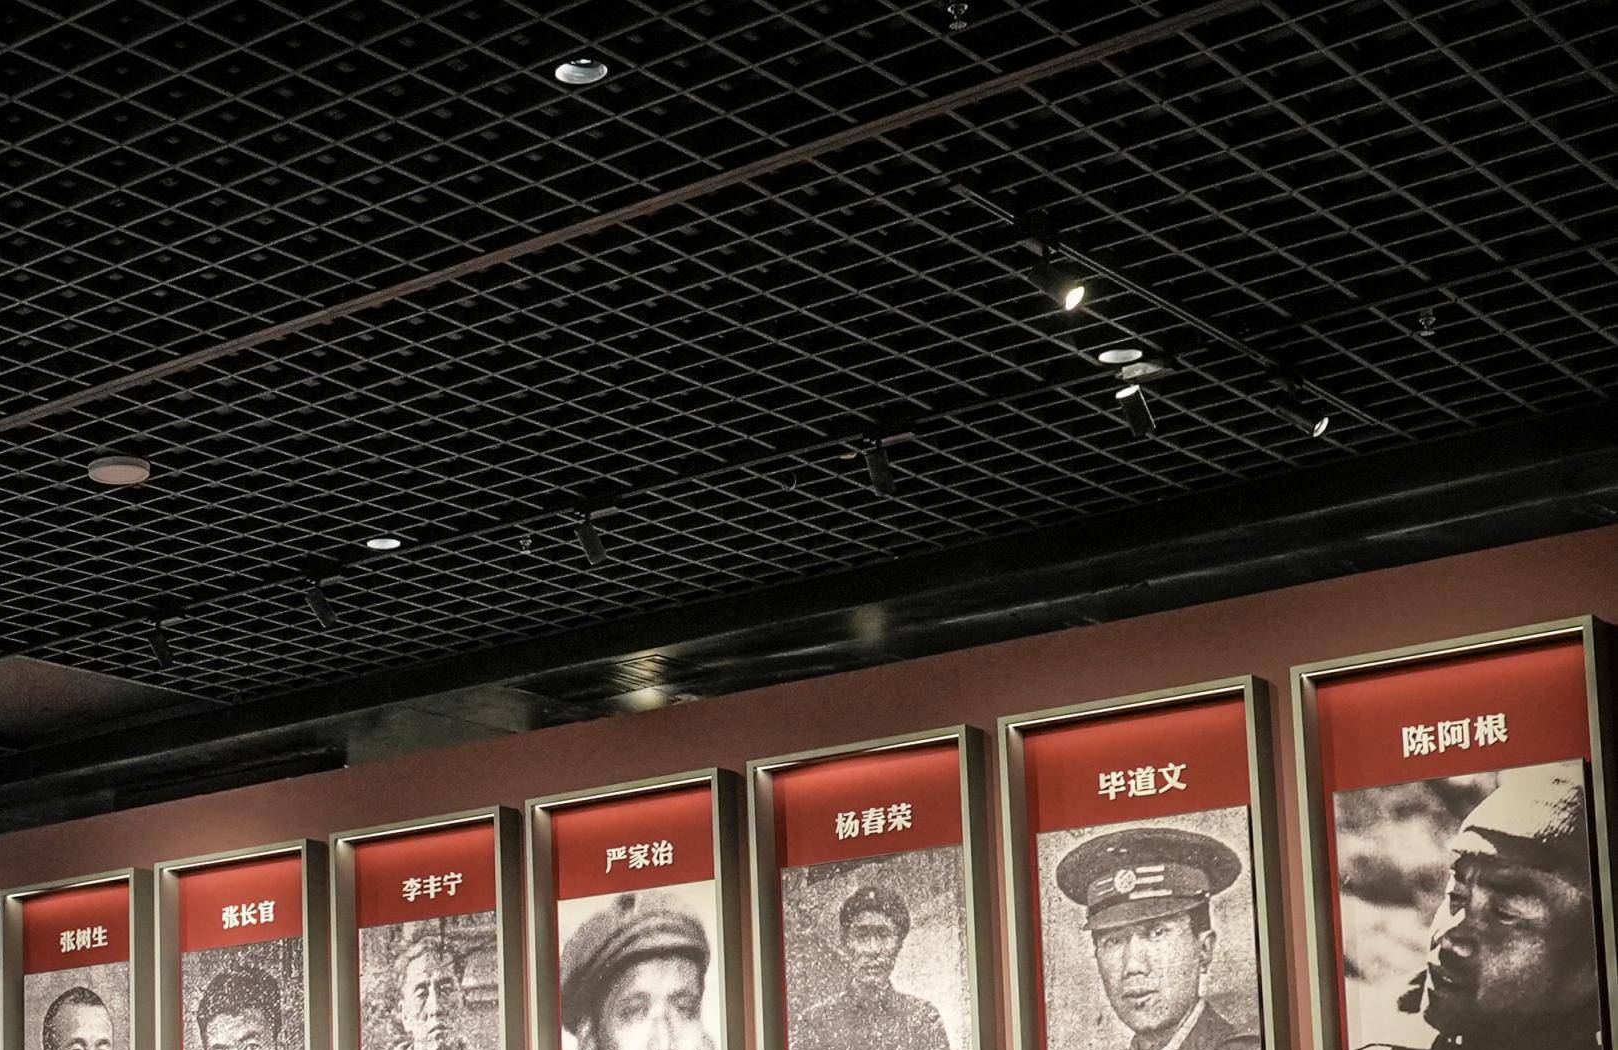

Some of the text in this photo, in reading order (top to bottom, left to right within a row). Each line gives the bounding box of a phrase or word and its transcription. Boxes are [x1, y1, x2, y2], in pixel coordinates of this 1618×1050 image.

[1402, 712, 1509, 758] 陈阿根
[1098, 762, 1188, 801] 毕道文
[835, 802, 913, 840] 杨春荣
[605, 840, 674, 873] 严家治
[402, 871, 463, 902] 李丰宁
[221, 900, 276, 930] 张长官
[59, 926, 109, 953] 张树生
